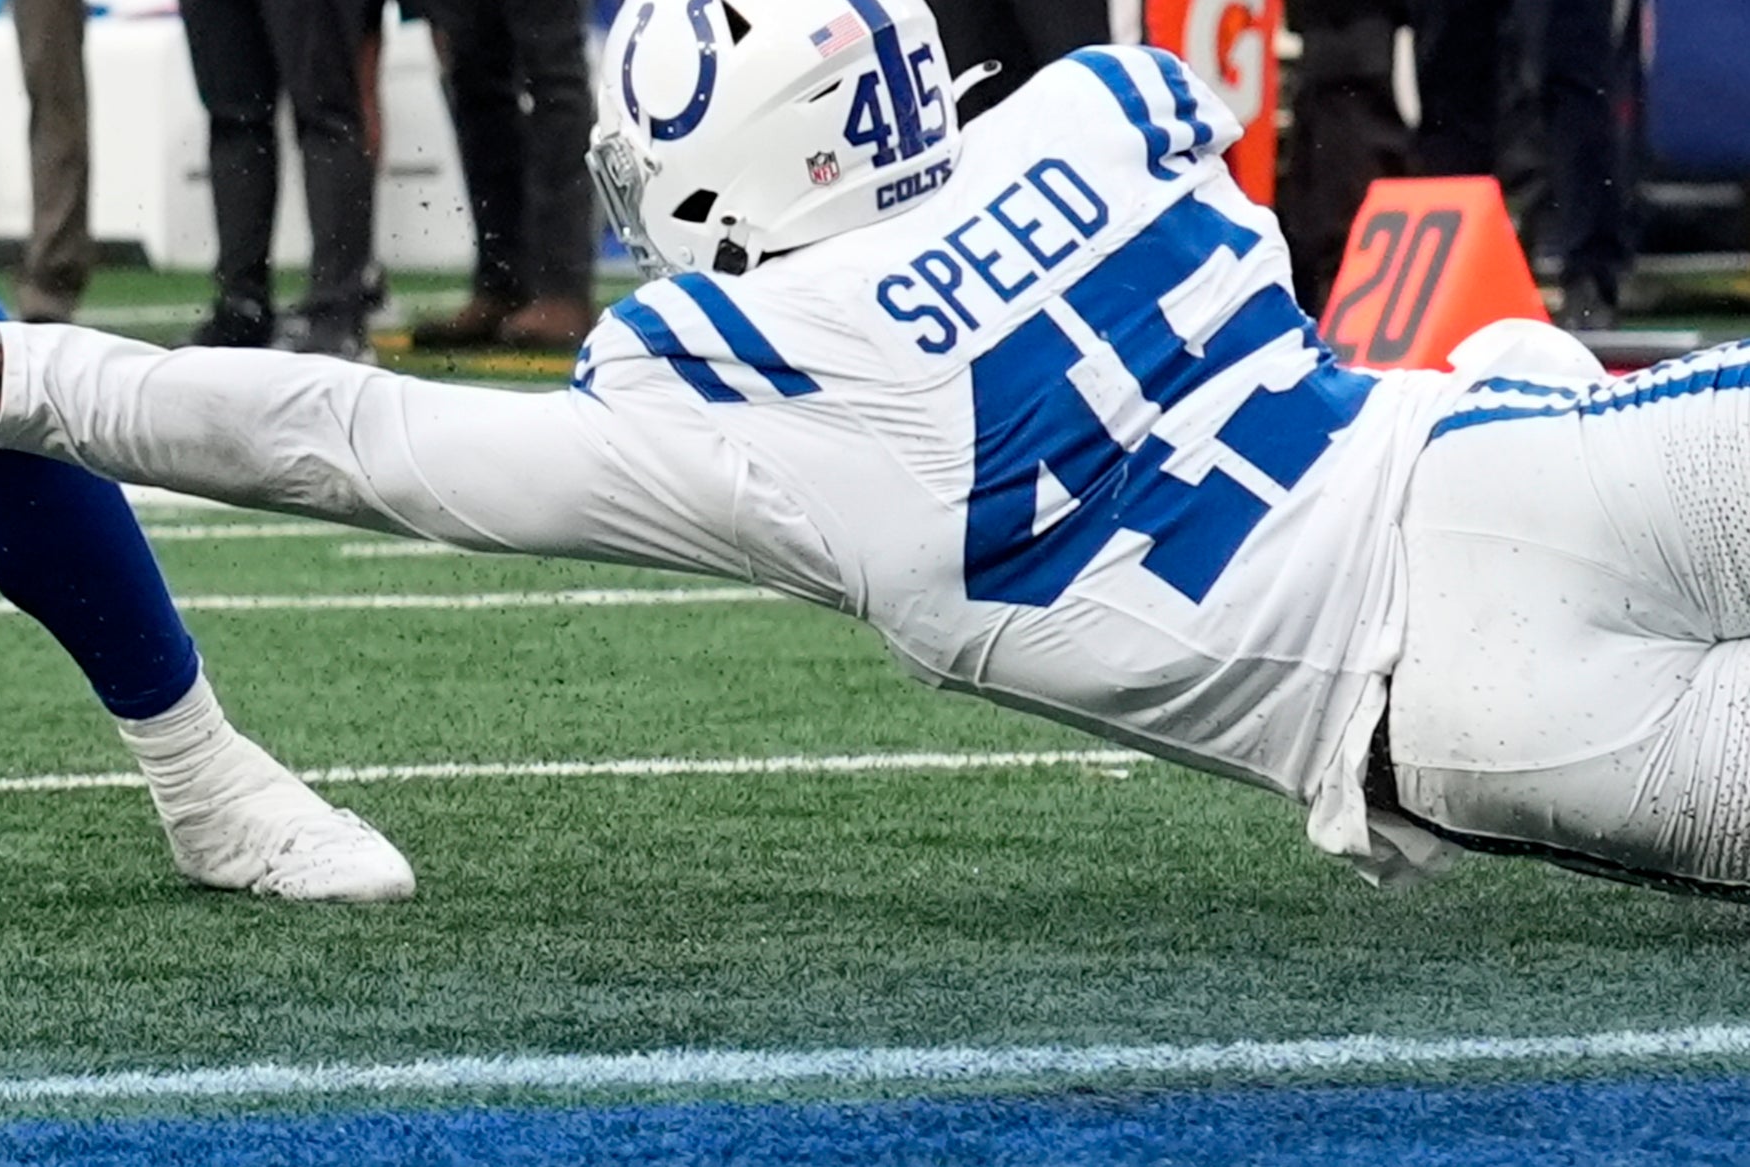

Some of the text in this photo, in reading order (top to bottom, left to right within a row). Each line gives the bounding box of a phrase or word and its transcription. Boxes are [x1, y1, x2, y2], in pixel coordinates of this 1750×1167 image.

[843, 42, 947, 168] 45
[876, 158, 1109, 354] SPEED
[877, 159, 952, 210] COLTS
[1324, 210, 1463, 363] 20
[963, 190, 1382, 608] 45
